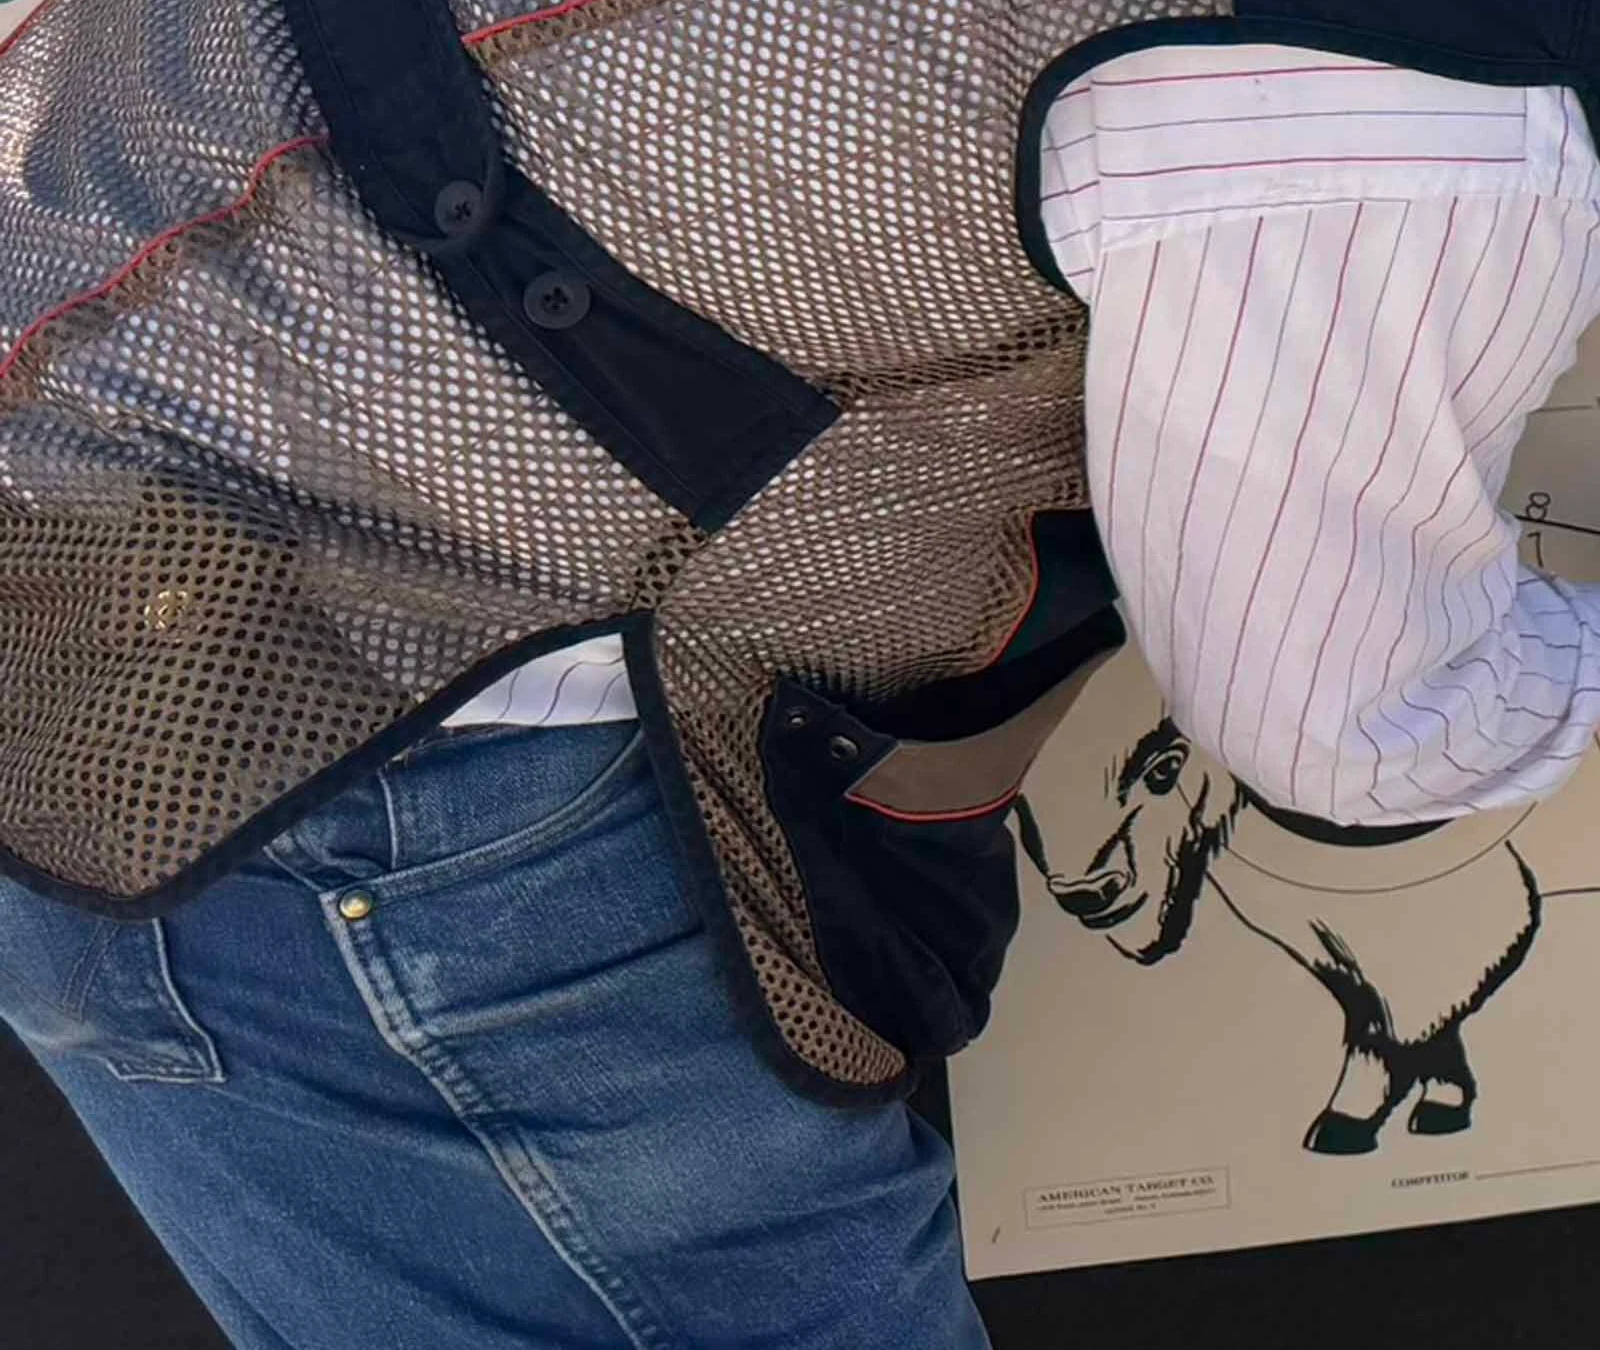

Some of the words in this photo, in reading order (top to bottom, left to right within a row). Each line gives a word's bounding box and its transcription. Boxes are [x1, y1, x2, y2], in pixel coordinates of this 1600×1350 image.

[1525, 492, 1551, 523] 8
[1038, 1186, 1122, 1203] AMERICAN
[1127, 1178, 1187, 1194] TARGET
